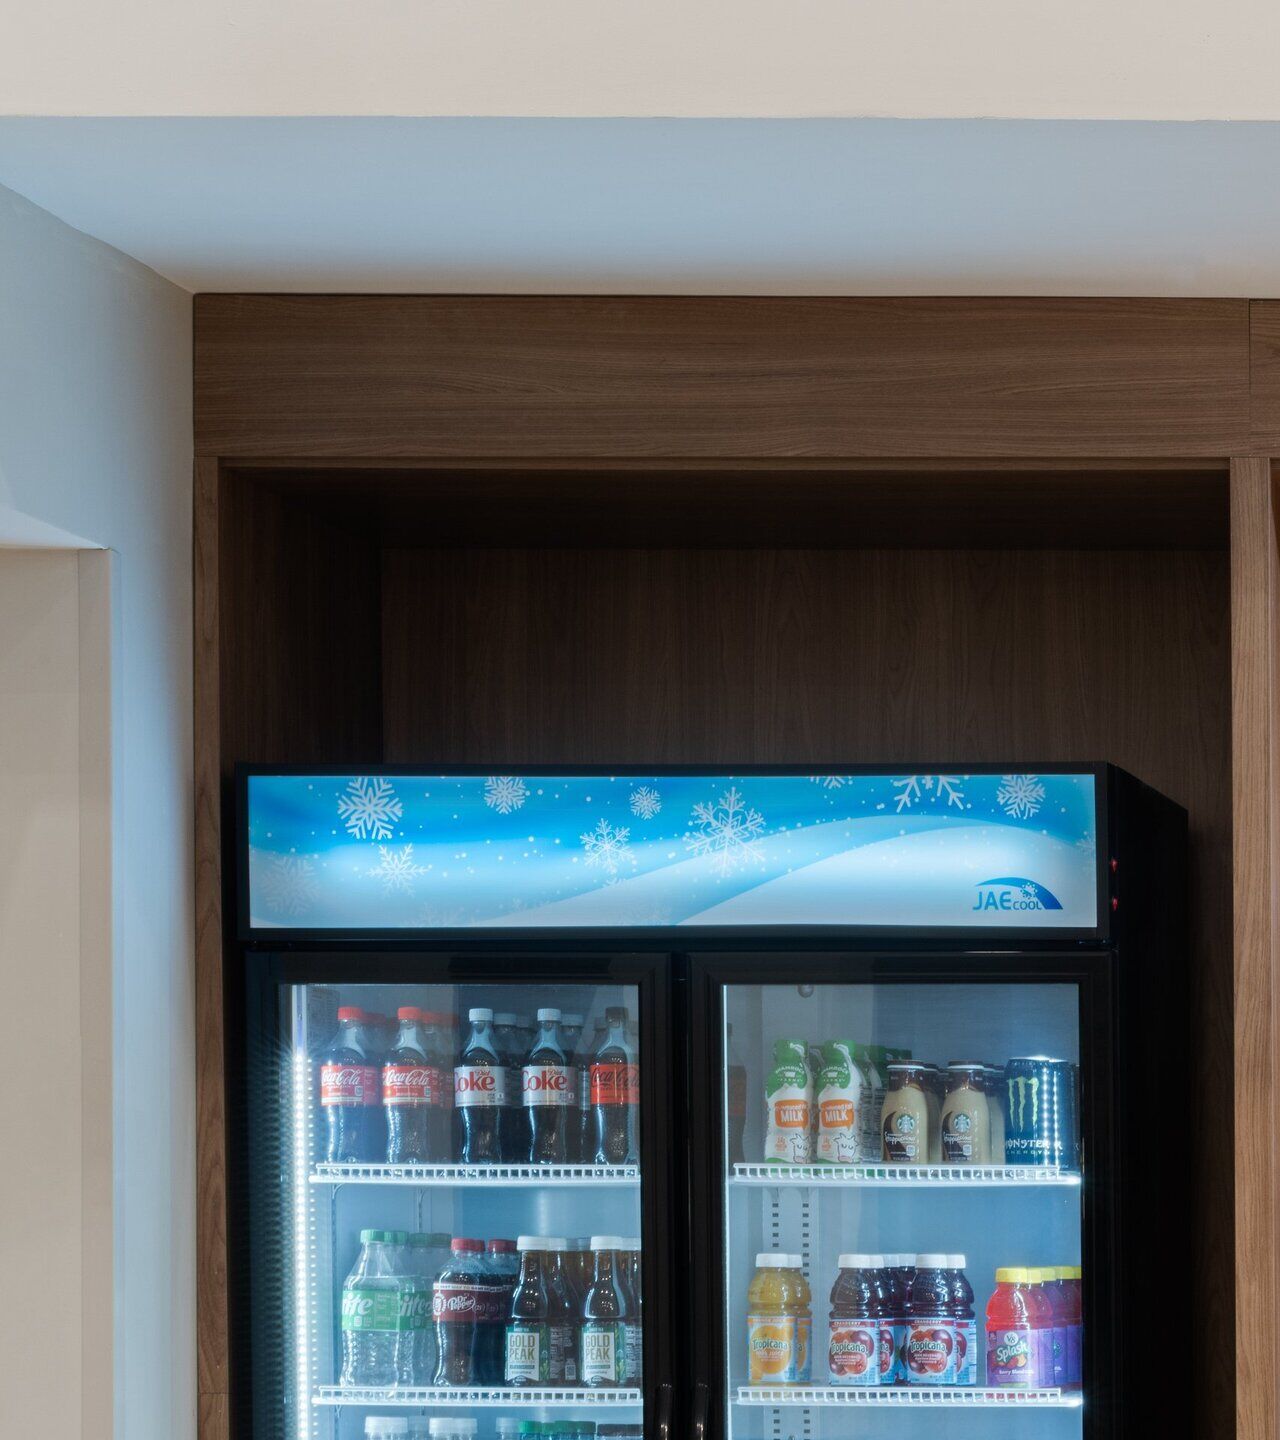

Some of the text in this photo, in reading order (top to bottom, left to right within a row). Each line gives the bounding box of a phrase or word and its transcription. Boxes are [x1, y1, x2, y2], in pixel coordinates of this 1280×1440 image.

[454, 1072, 495, 1091] Coke
[522, 1072, 568, 1091] Coke
[780, 1110, 804, 1122] MILK
[825, 1110, 849, 1122] MILK
[509, 1335, 535, 1348] GOLD
[584, 1335, 611, 1348] GOLD
[751, 1338, 788, 1351] Tropicana
[831, 1340, 867, 1353] Tropicana
[910, 1340, 947, 1353] Tropicana
[509, 1349, 535, 1361] PEAK
[585, 1349, 611, 1361] PEAK
